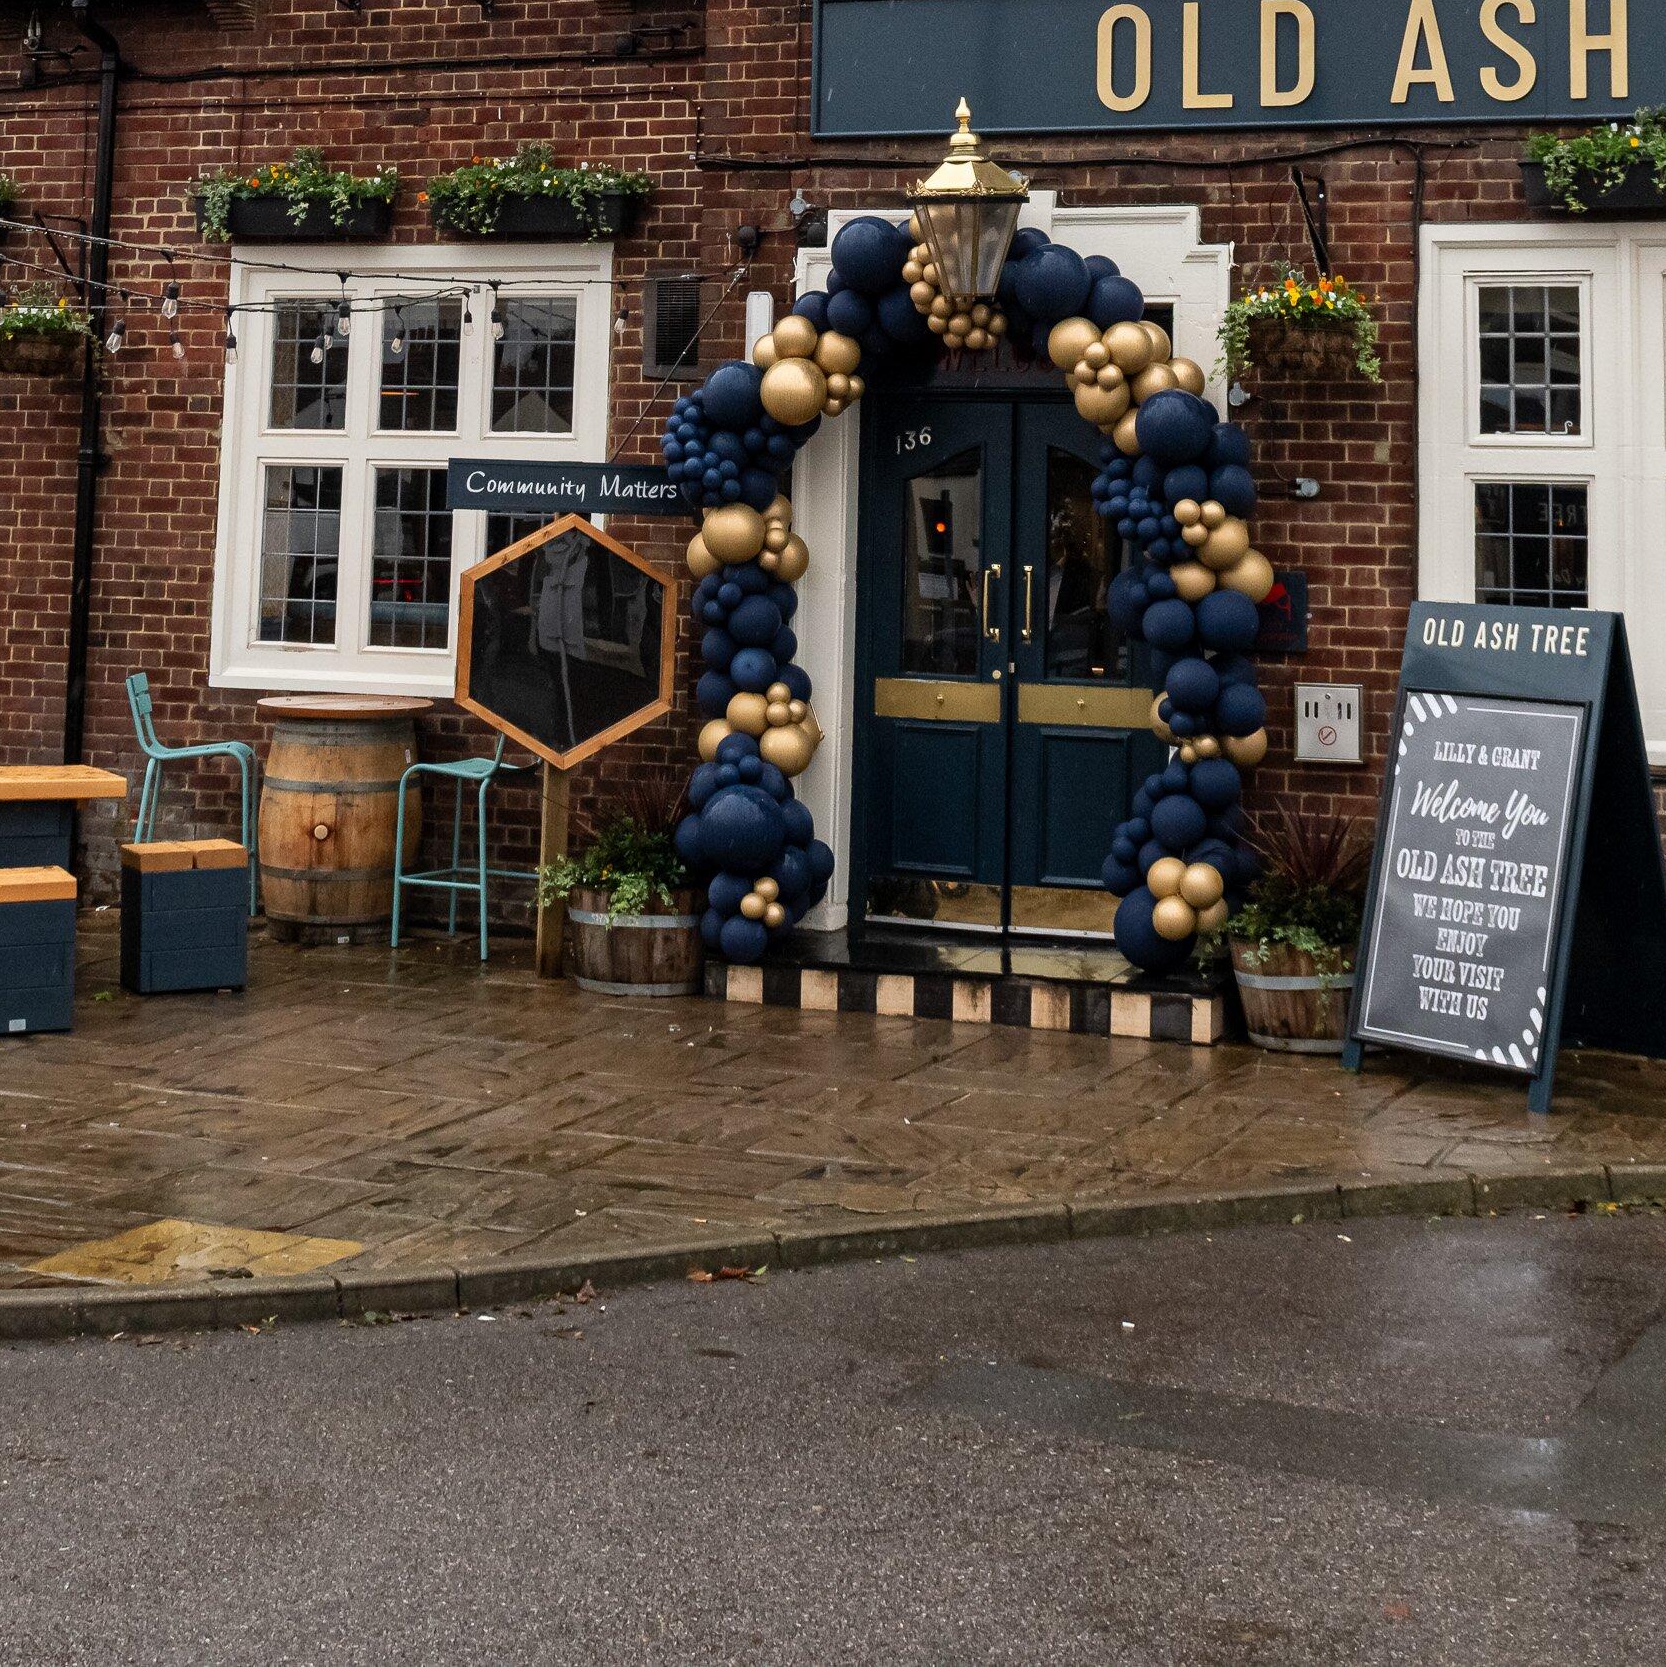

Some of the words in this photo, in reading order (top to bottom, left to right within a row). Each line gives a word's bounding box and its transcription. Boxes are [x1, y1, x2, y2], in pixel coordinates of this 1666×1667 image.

[896, 426, 932, 455] 136
[465, 470, 586, 502] Community
[599, 474, 678, 499] Matters
[1422, 617, 1465, 648] OLD
[1473, 621, 1520, 651] ASH
[1531, 624, 1590, 656] TREE
[1433, 741, 1477, 764] LILLY
[1477, 745, 1488, 766] &
[1491, 746, 1541, 771] GRANT
[1410, 779, 1501, 824] Welcome
[1502, 788, 1550, 840] You
[1455, 828, 1470, 847] TO
[1471, 829, 1496, 850] THE
[1396, 847, 1438, 882] OLD
[1439, 853, 1486, 889] ASH
[1489, 859, 1549, 898] TREE
[1413, 892, 1438, 919] WE
[1439, 897, 1484, 926] HOPE
[1487, 904, 1521, 932] YOU
[1435, 927, 1489, 958] ENJOY
[1412, 953, 1456, 984] YOUR
[1458, 961, 1505, 992] VISIT
[1418, 985, 1463, 1016] WITH
[1466, 993, 1489, 1021] US
